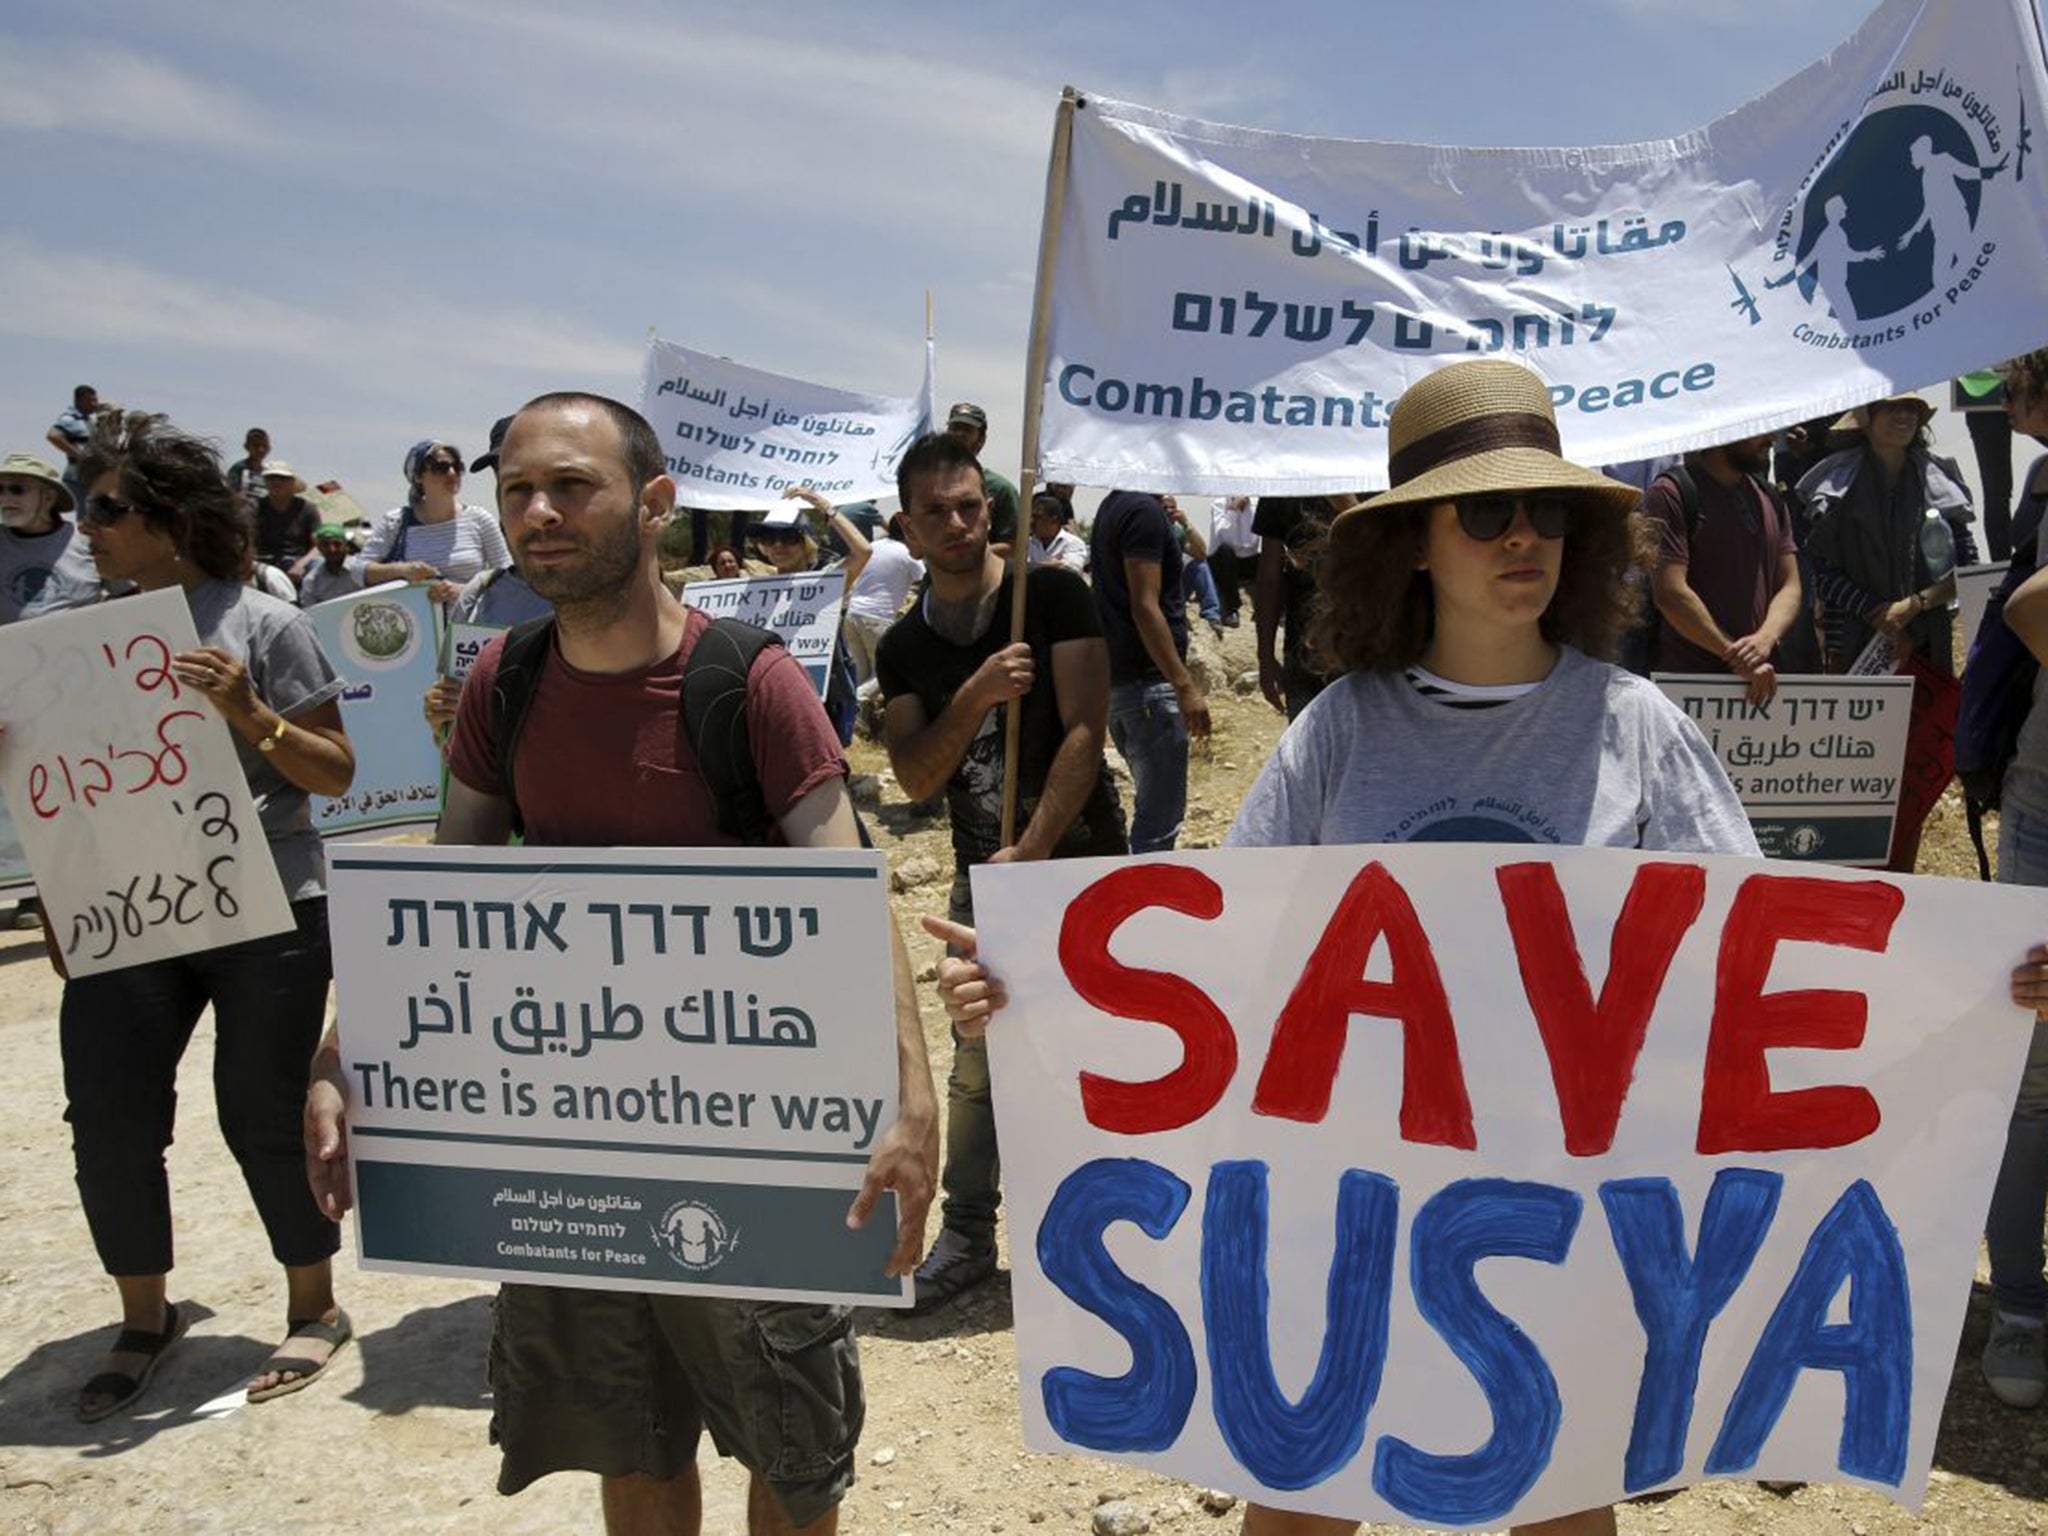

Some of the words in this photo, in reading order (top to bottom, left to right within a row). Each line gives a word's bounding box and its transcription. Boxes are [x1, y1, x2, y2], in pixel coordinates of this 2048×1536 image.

[1942, 79, 1963, 98] من
[1108, 181, 1275, 240] السلام
[1793, 323, 1905, 350] Combatants
[1913, 305, 1942, 331] for
[1945, 241, 1996, 304] Peace
[1172, 290, 1375, 345] לשלום
[657, 377, 727, 408] السلام
[772, 408, 799, 426] من
[802, 415, 876, 436] مقاتلون
[676, 420, 756, 454] לשלום
[760, 443, 839, 466] לוחמים
[664, 455, 760, 489] mbatants
[764, 474, 794, 491] for
[698, 590, 752, 609] אחרת
[758, 587, 794, 607] דרך
[800, 586, 824, 601] יש
[772, 611, 816, 628] هناك
[798, 637, 830, 651] way
[1683, 697, 1771, 721] אחרת
[1782, 699, 1838, 726] דרך
[1847, 699, 1885, 721] יש
[1727, 734, 1800, 766] طريق
[1809, 735, 1875, 759] هناك
[1751, 772, 1843, 795] another
[1851, 776, 1896, 800] way
[387, 898, 568, 952] אחרת
[588, 903, 710, 966] דרך
[734, 905, 818, 958] יש
[399, 971, 472, 1049] آخر
[664, 989, 817, 1048] هناك
[1058, 861, 1906, 1156] SAVE
[492, 986, 644, 1058] طريق
[353, 1062, 486, 1113] There
[500, 1068, 538, 1117] is
[553, 1075, 756, 1129] another
[771, 1094, 884, 1149] way
[493, 1187, 536, 1207] السلام
[566, 1195, 585, 1208] من
[588, 1195, 642, 1213] مقاتلون
[511, 1216, 564, 1234] לשלום
[567, 1220, 627, 1239] לוחמים
[497, 1240, 577, 1261] Combatants
[581, 1248, 601, 1261] for
[605, 1250, 647, 1266] Peace
[1036, 1157, 1915, 1526] SUSYA
